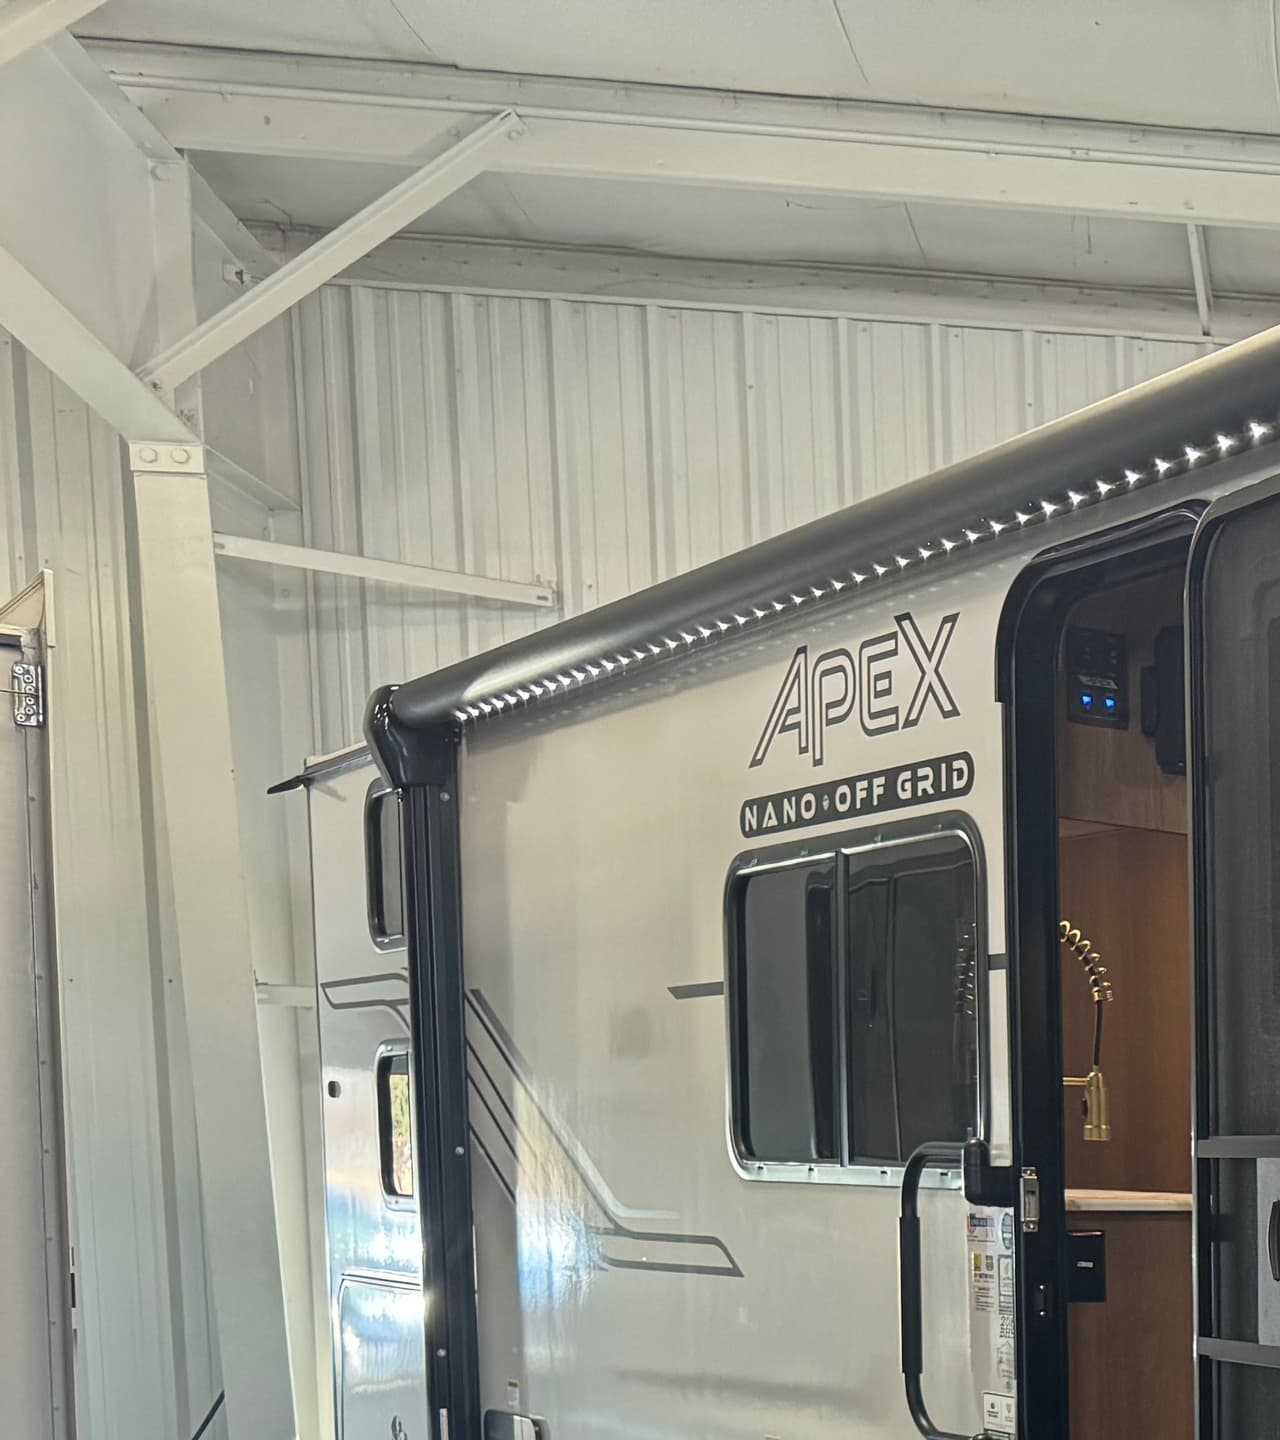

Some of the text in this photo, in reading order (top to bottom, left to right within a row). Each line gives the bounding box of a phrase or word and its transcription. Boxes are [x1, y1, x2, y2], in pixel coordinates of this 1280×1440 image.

[744, 758, 969, 832] NANO OFF GRID
